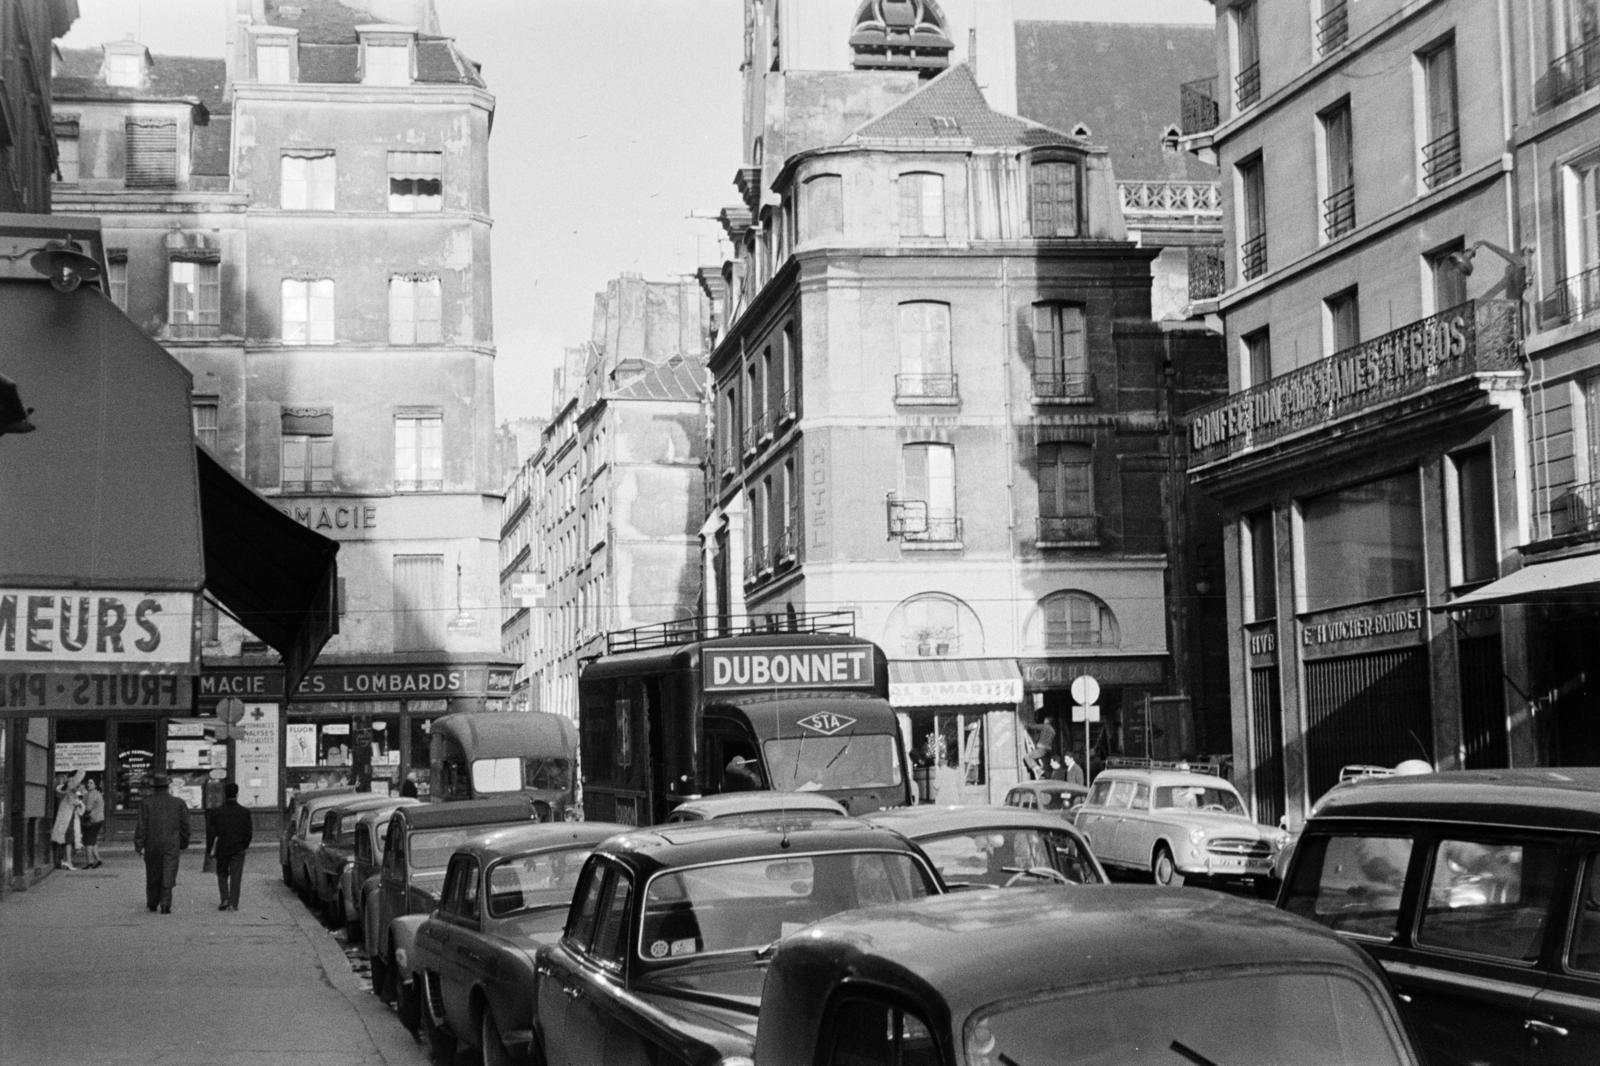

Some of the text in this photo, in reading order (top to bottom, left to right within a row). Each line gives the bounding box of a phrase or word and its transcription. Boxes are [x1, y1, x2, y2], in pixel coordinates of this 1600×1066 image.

[1193, 386, 1281, 449] CONFECTION
[1321, 349, 1379, 403] DAMES
[1410, 316, 1466, 371] GROS
[343, 672, 461, 693] LOMBARDS
[712, 651, 867, 686] DUBONNET
[811, 714, 841, 729] STA
